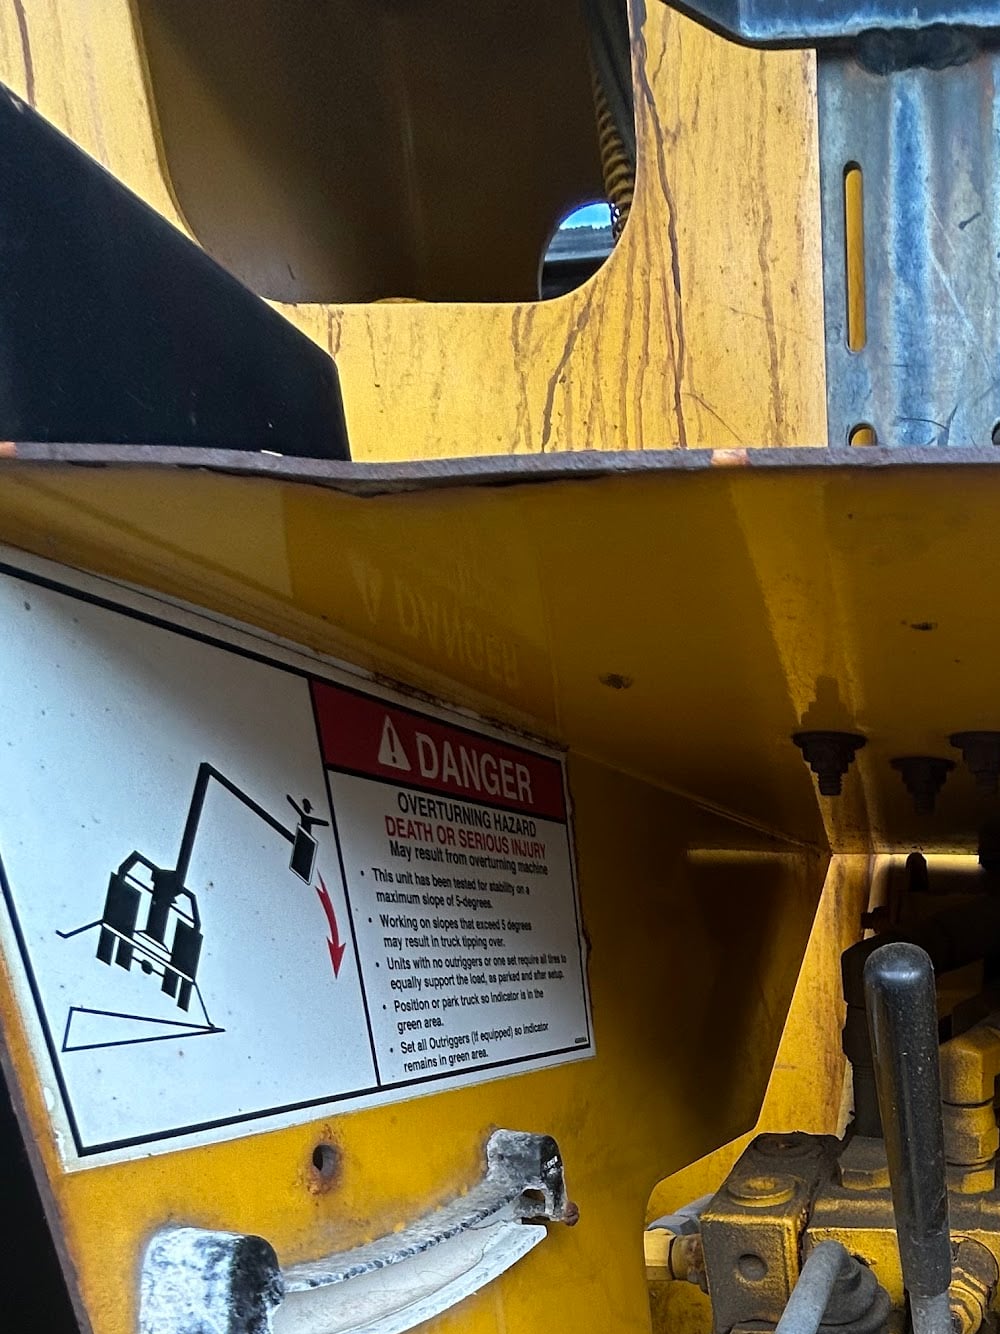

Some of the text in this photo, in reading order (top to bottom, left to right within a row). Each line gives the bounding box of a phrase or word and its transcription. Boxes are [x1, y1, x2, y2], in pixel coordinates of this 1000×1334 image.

[415, 731, 534, 804] DANGER
[398, 791, 537, 837] OVERTURNING HAZARD
[385, 815, 546, 860] DEATH OR SERIOUS INJURY
[390, 841, 548, 875] May result from overturning machine
[372, 868, 530, 896] This unit has been tested for stability on a
[376, 890, 420, 904] maximum
[422, 893, 444, 908] slope
[446, 894, 454, 906] of
[379, 914, 532, 933] Working on slopes that exceed 5 degrees
[384, 934, 506, 950] may result in truck tipping over.
[387, 957, 411, 970] Units
[413, 957, 431, 969] with
[433, 959, 443, 968] no
[445, 956, 483, 970] outriggers
[484, 957, 491, 966] or
[493, 957, 506, 966] one
[507, 955, 517, 966] set
[518, 955, 539, 967] require
[561, 954, 567, 964] to
[391, 976, 422, 992] equally
[424, 974, 455, 990] support
[456, 974, 468, 985] the
[469, 973, 487, 985] load,
[489, 974, 496, 983] as
[498, 971, 520, 985] parked
[521, 970, 532, 980] and
[533, 969, 546, 980] after
[394, 988, 544, 1012] Position or park truck so indicator is in the
[397, 1017, 444, 1035] green area.
[401, 1022, 549, 1054] Set all Outriggers (if equipped) so indicator
[403, 1048, 489, 1072] remains in green area.
